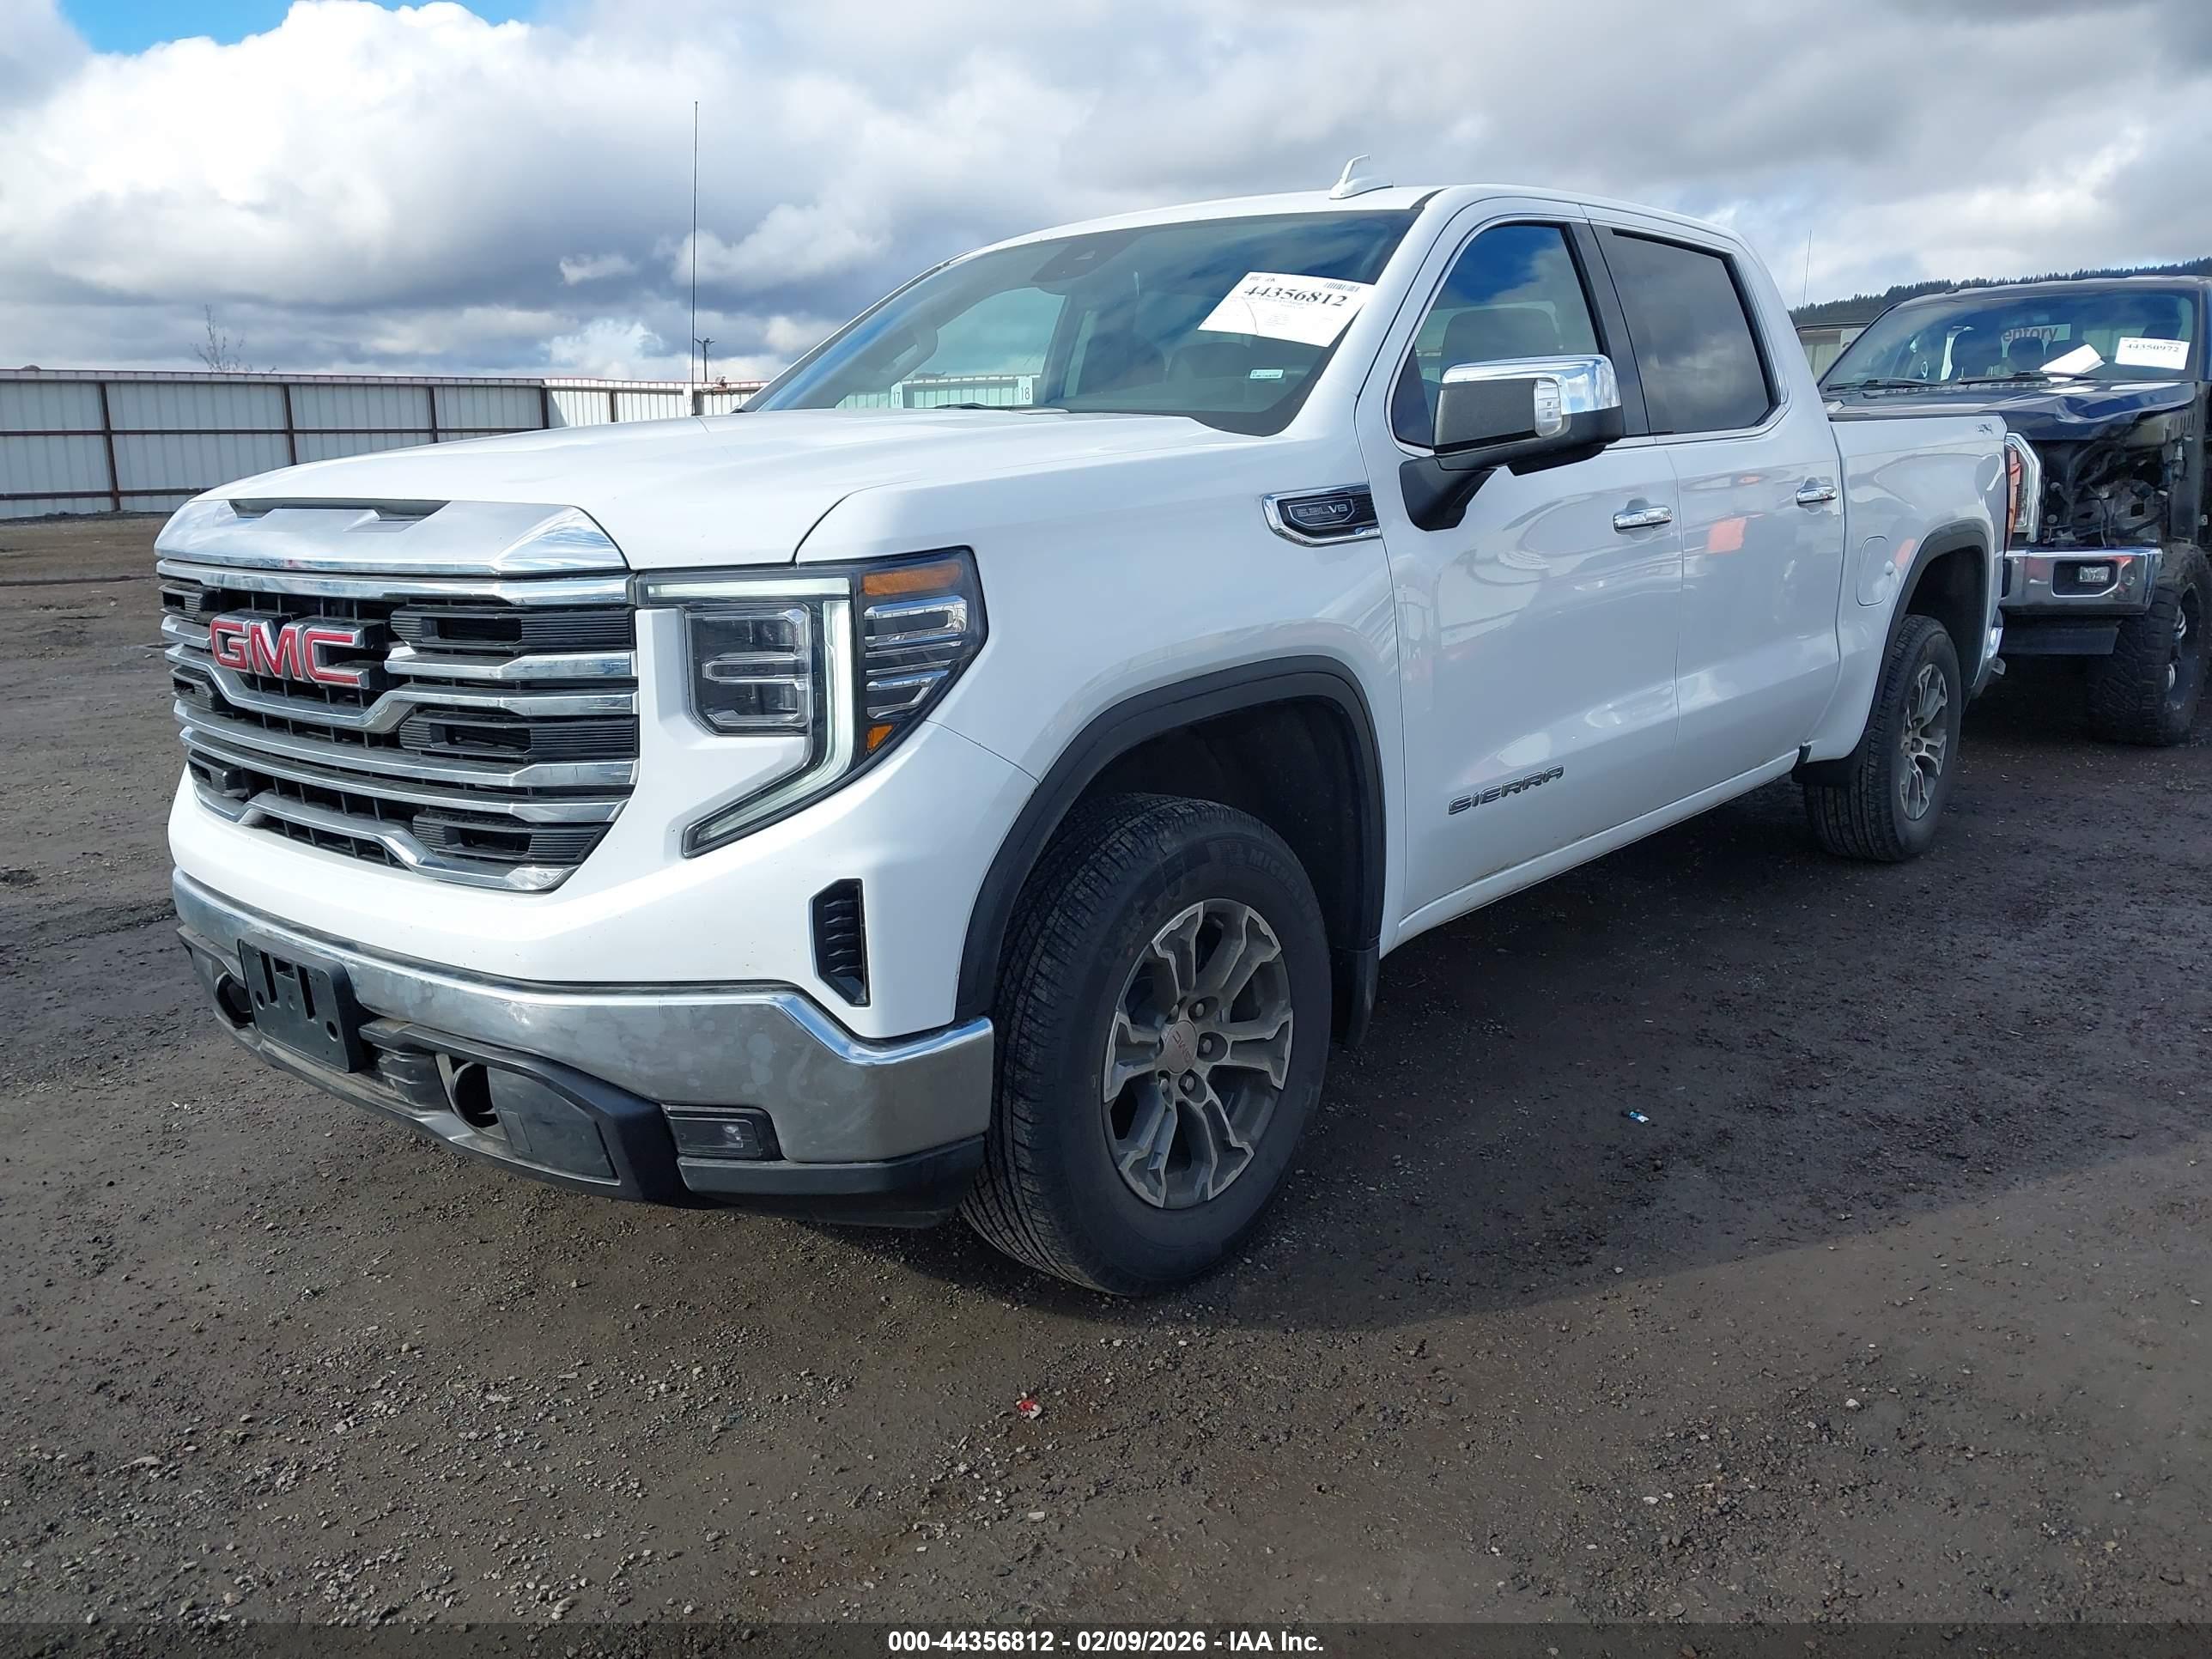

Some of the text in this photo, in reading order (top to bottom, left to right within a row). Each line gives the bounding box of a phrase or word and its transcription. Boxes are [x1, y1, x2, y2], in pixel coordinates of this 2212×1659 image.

[1243, 285, 1348, 307] 44356812
[893, 392, 901, 405] 17
[1020, 386, 1030, 401] 18
[210, 617, 370, 690] GMC
[1448, 764, 1565, 816] SIERRA
